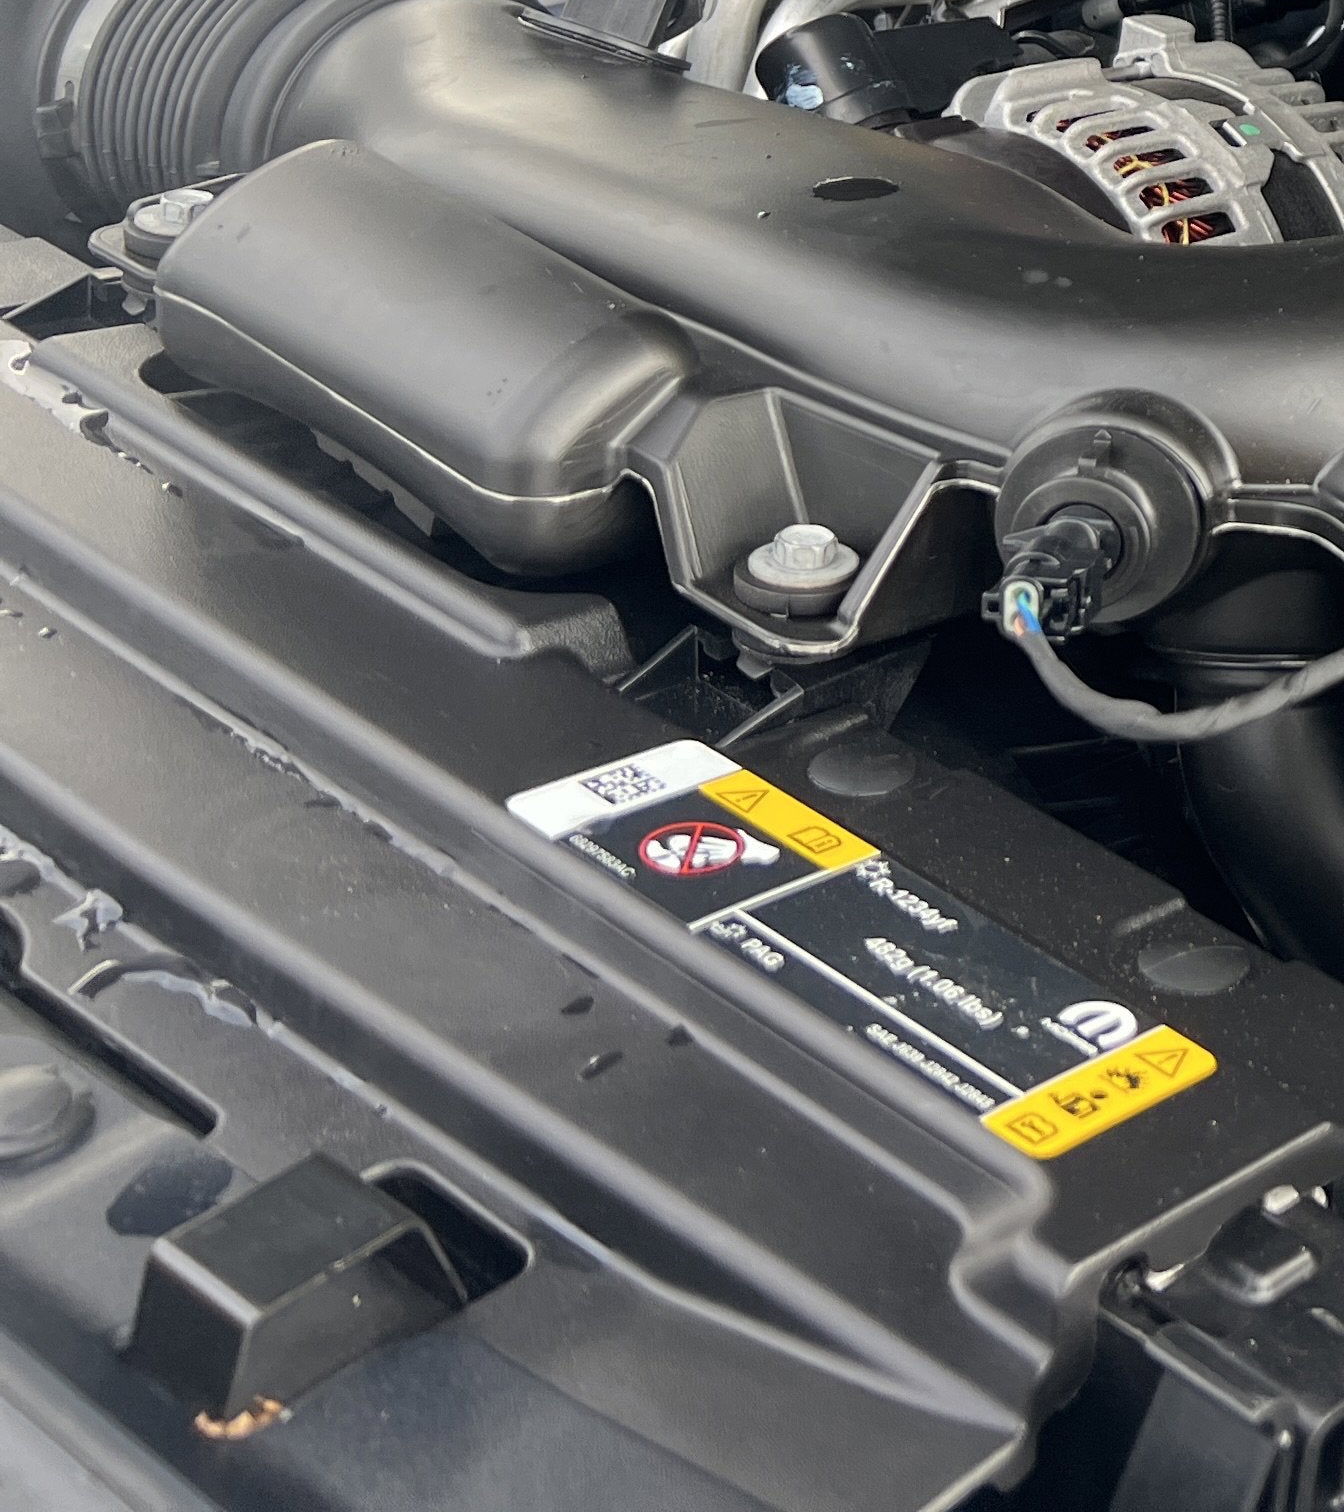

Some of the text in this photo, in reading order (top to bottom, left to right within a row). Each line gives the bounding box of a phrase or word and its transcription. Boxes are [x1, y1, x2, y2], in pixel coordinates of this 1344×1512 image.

[869, 877, 959, 934] R-1234yf
[741, 938, 785, 973] PAG
[864, 937, 1004, 1030] 482g (1.06 lbs)
[866, 1023, 899, 1049] SAE
